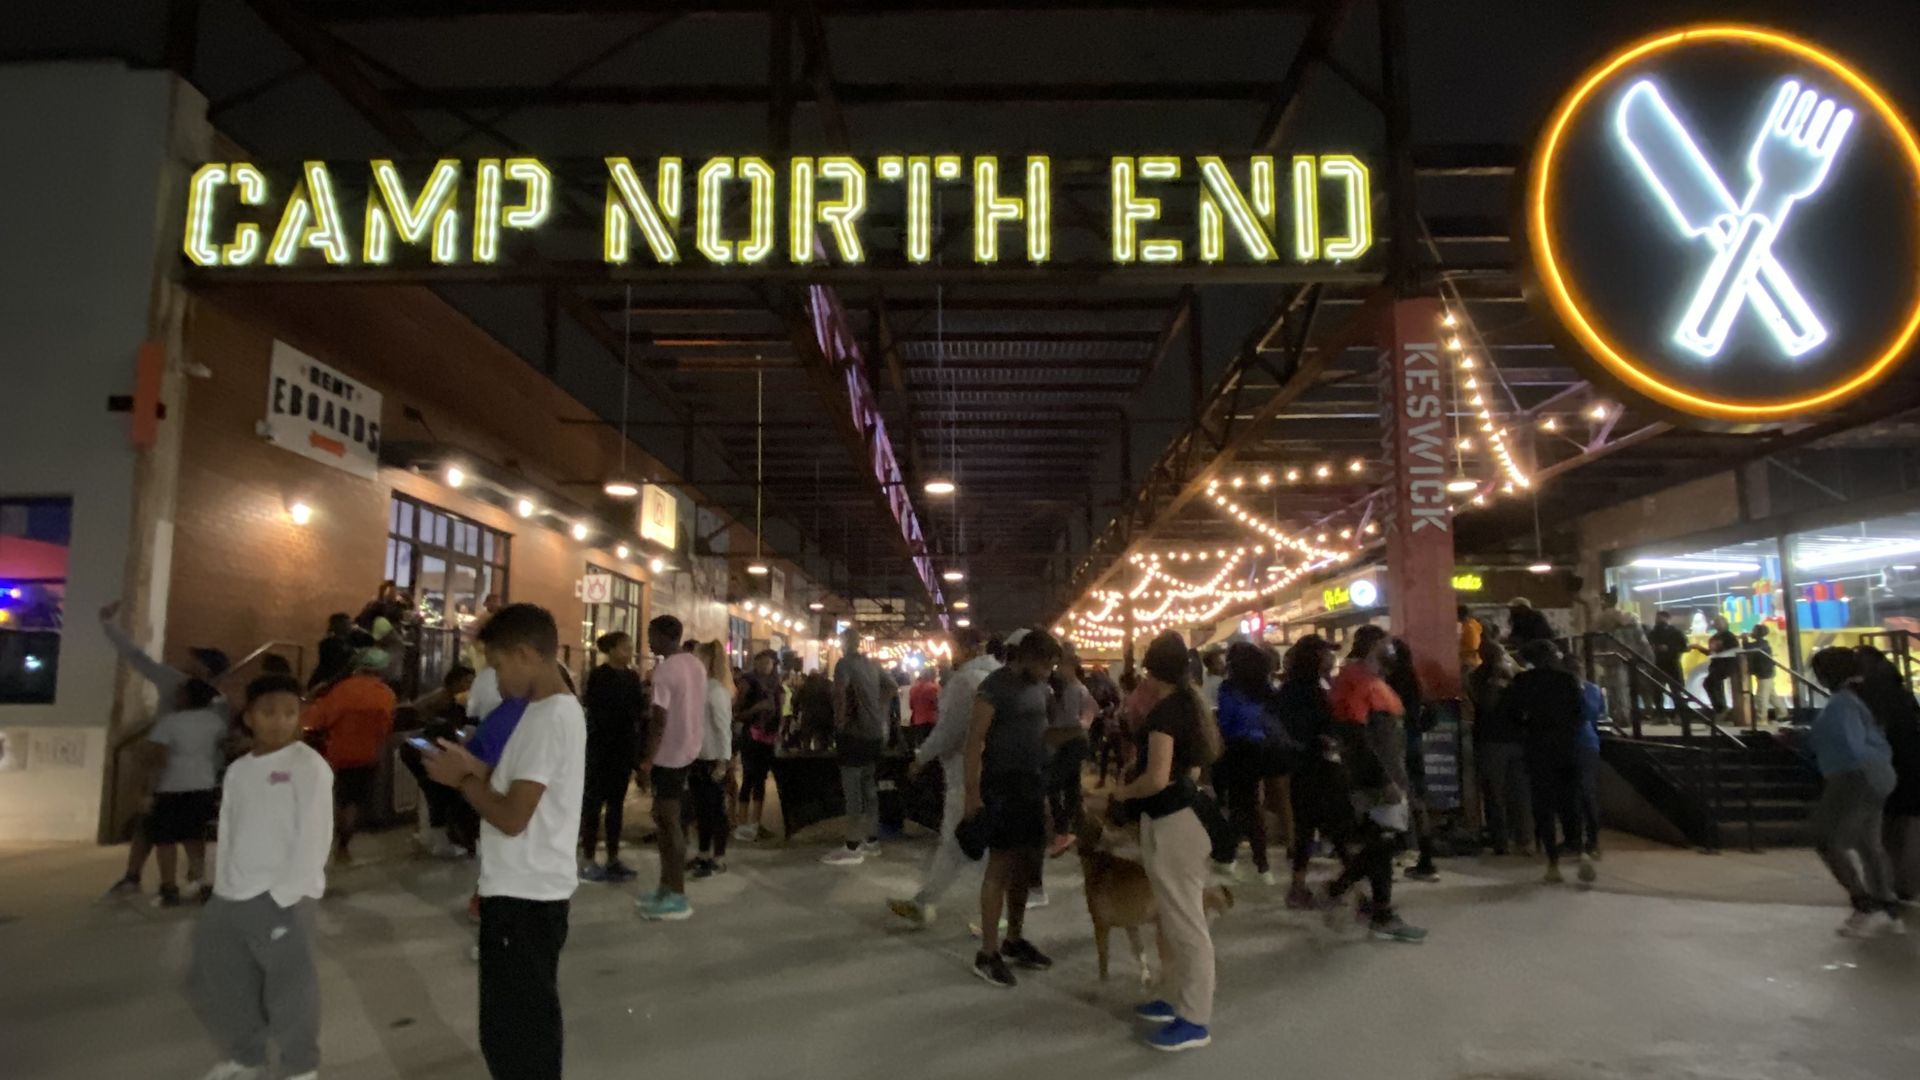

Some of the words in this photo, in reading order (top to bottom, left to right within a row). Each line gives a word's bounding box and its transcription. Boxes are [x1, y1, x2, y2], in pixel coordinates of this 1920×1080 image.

[184, 158, 551, 265] CAMP
[604, 156, 1050, 262] NORTH
[1111, 155, 1372, 262] END
[273, 377, 379, 453] EBOARDS
[309, 366, 354, 401] RENT
[1403, 343, 1447, 532] KESWICK
